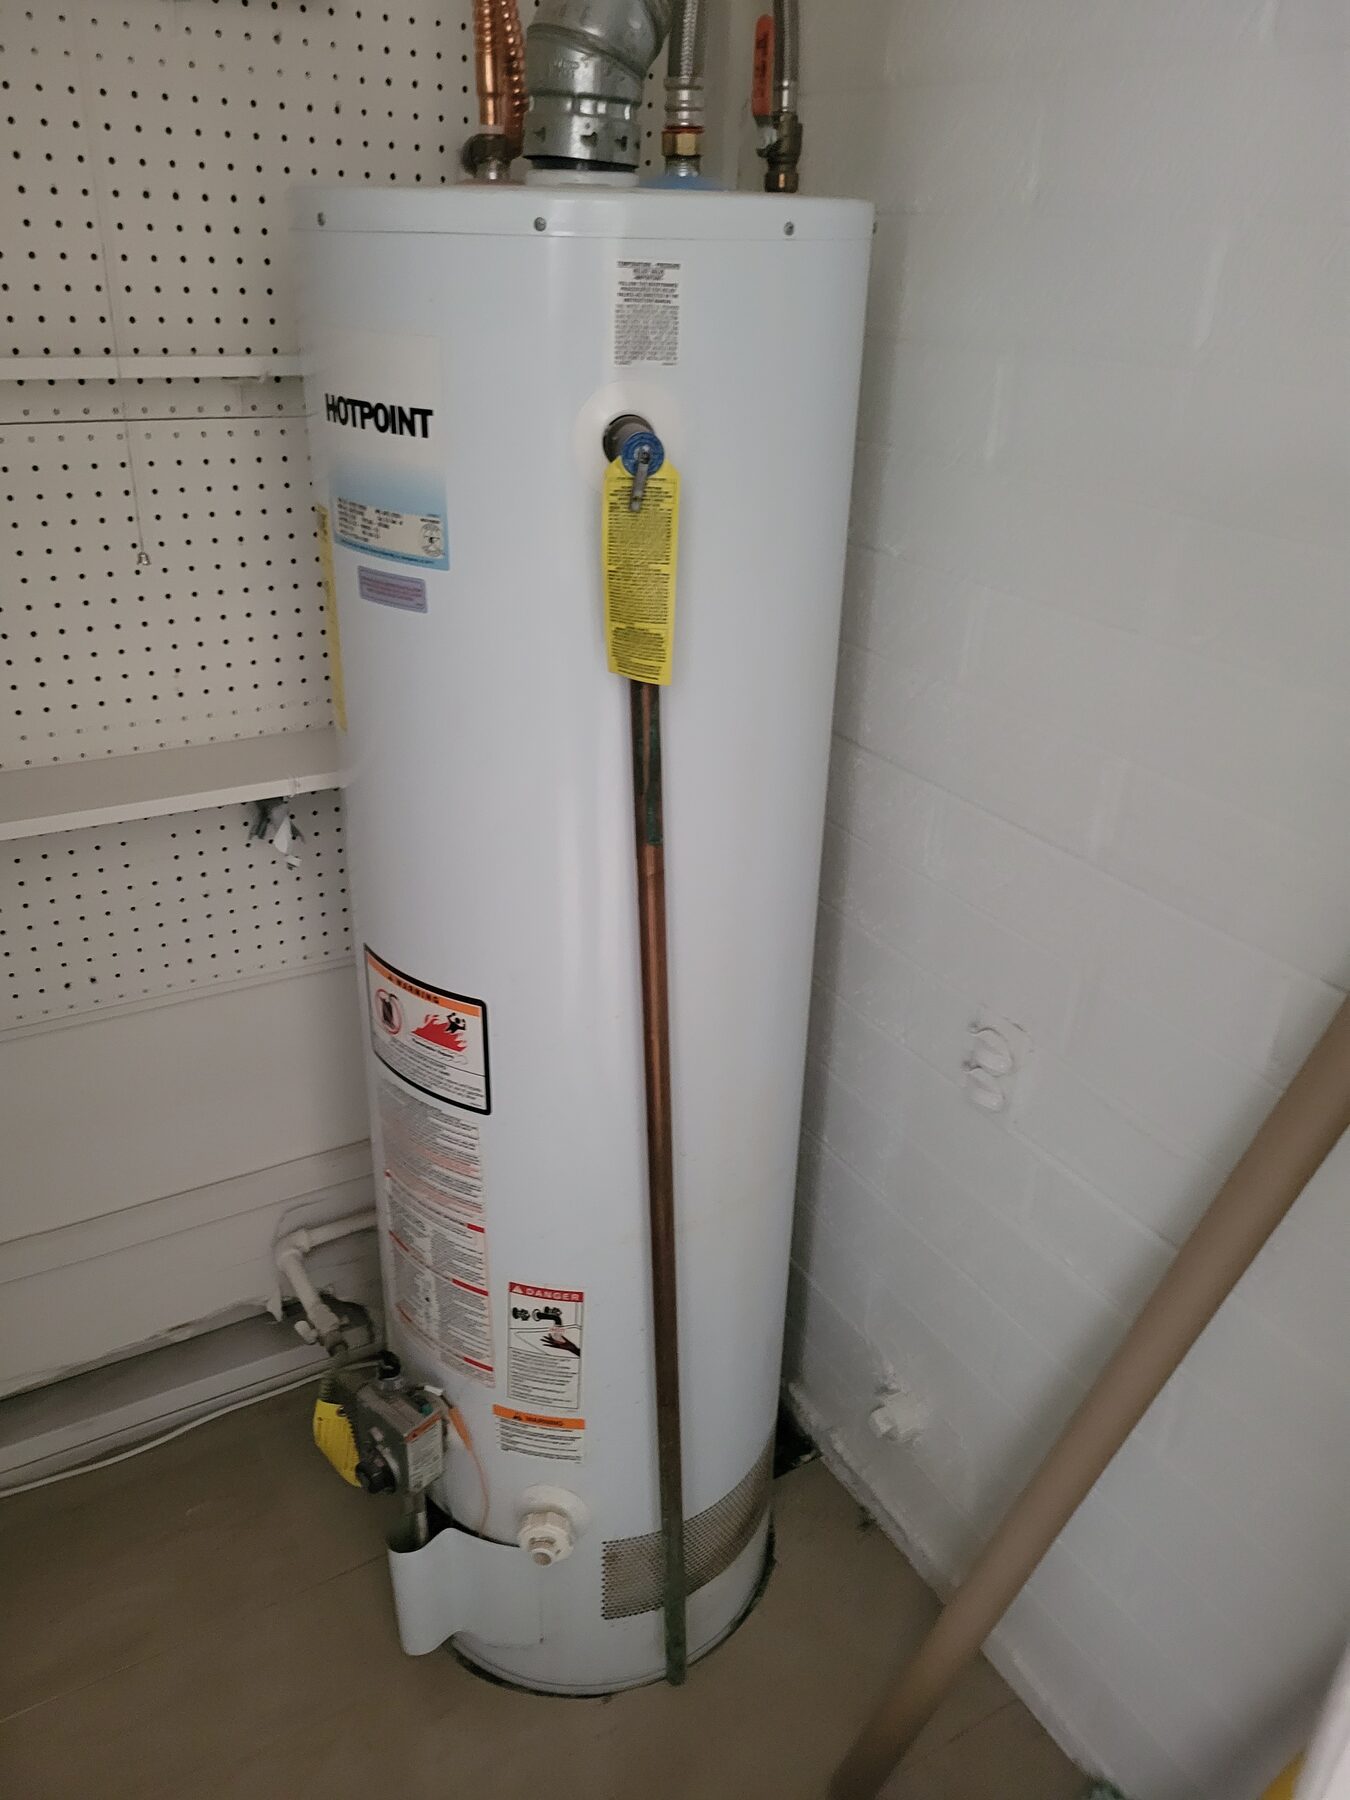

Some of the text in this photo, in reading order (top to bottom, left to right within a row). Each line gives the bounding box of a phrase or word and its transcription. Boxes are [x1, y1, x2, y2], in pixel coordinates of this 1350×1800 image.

[325, 393, 433, 438] HOTPOINT
[396, 979, 440, 1004] WARNING
[525, 1288, 580, 1301] DANGER
